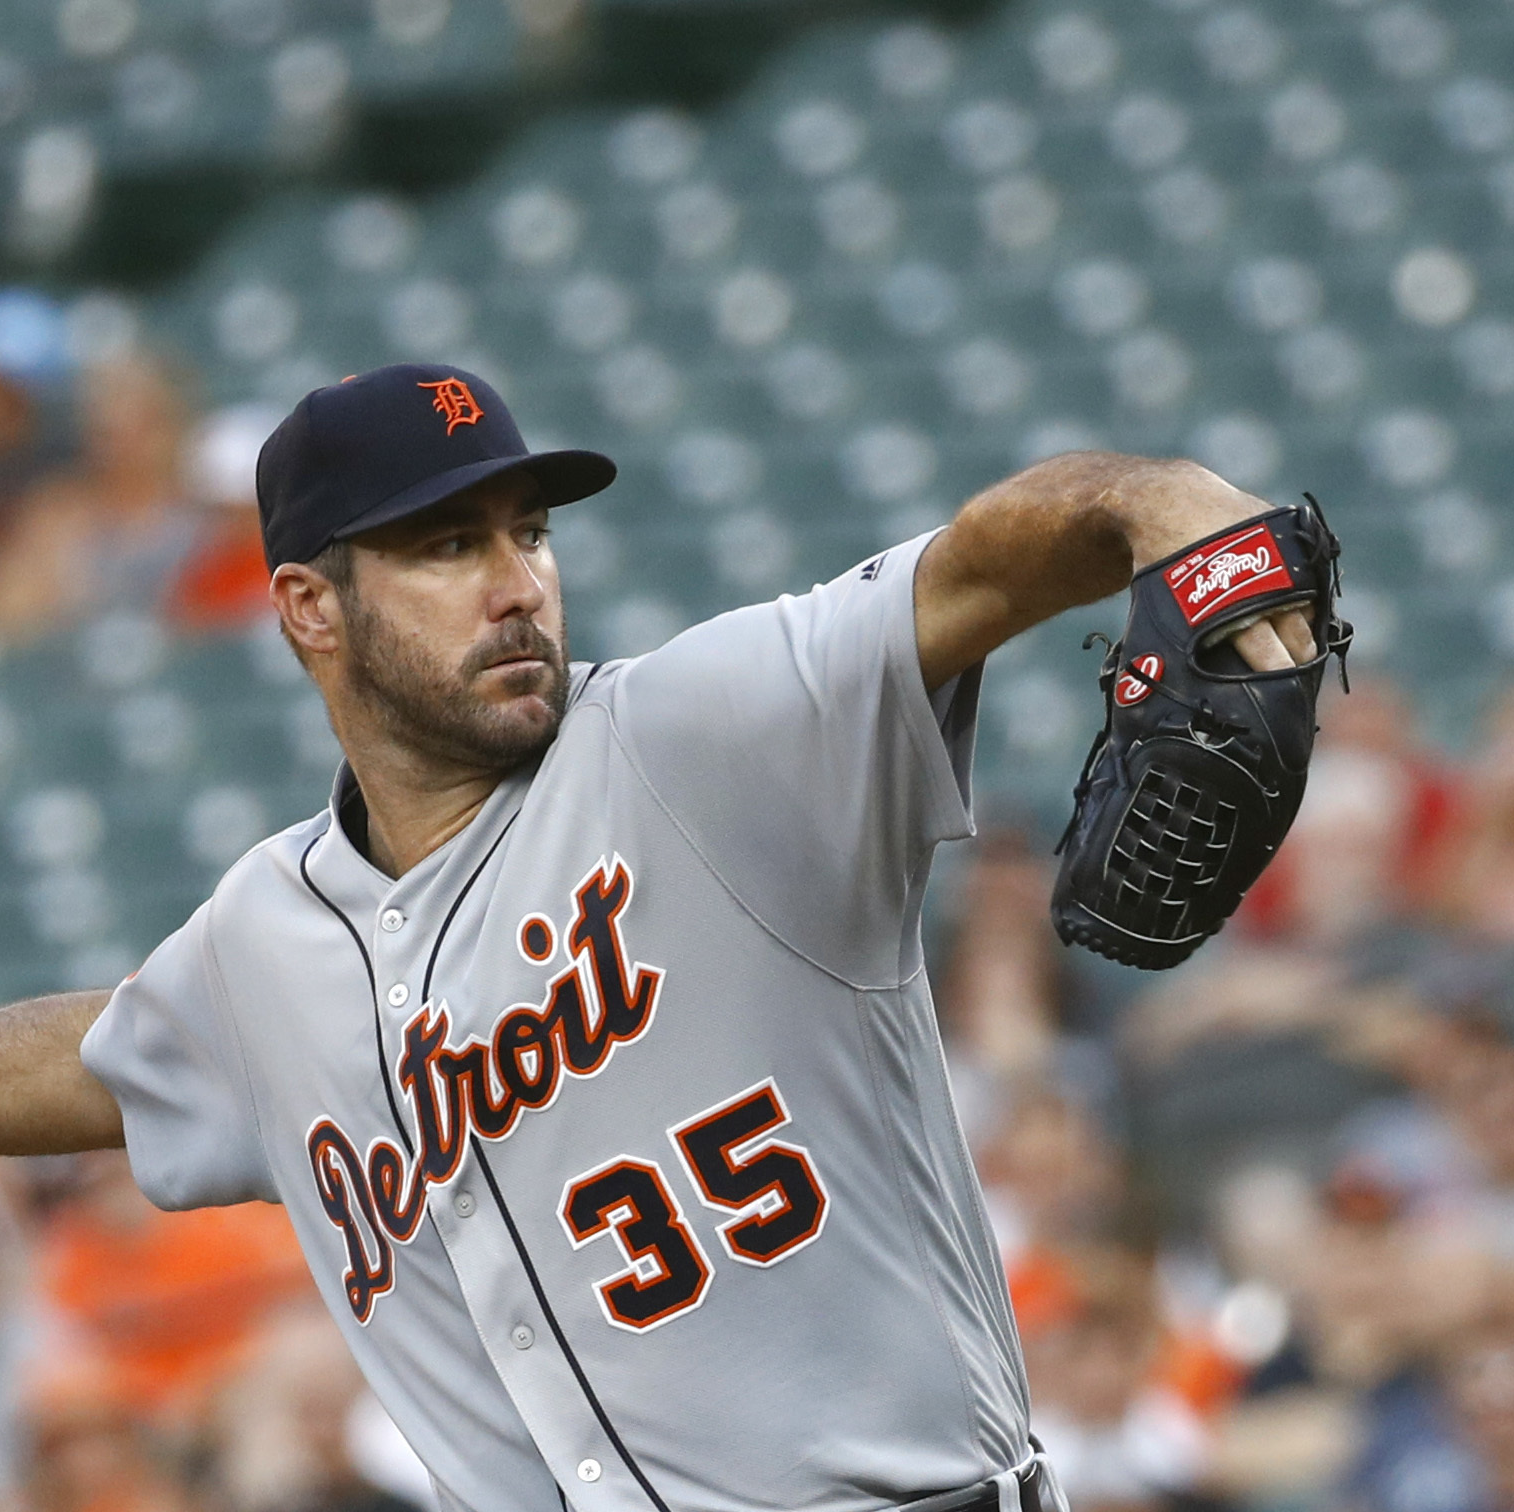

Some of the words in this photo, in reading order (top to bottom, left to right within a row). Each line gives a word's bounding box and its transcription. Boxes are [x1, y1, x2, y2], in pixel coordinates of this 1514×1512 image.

[417, 376, 485, 436] D
[1188, 546, 1270, 603] Rawlings
[305, 852, 666, 1327] Detroit
[555, 1076, 830, 1334] 35
